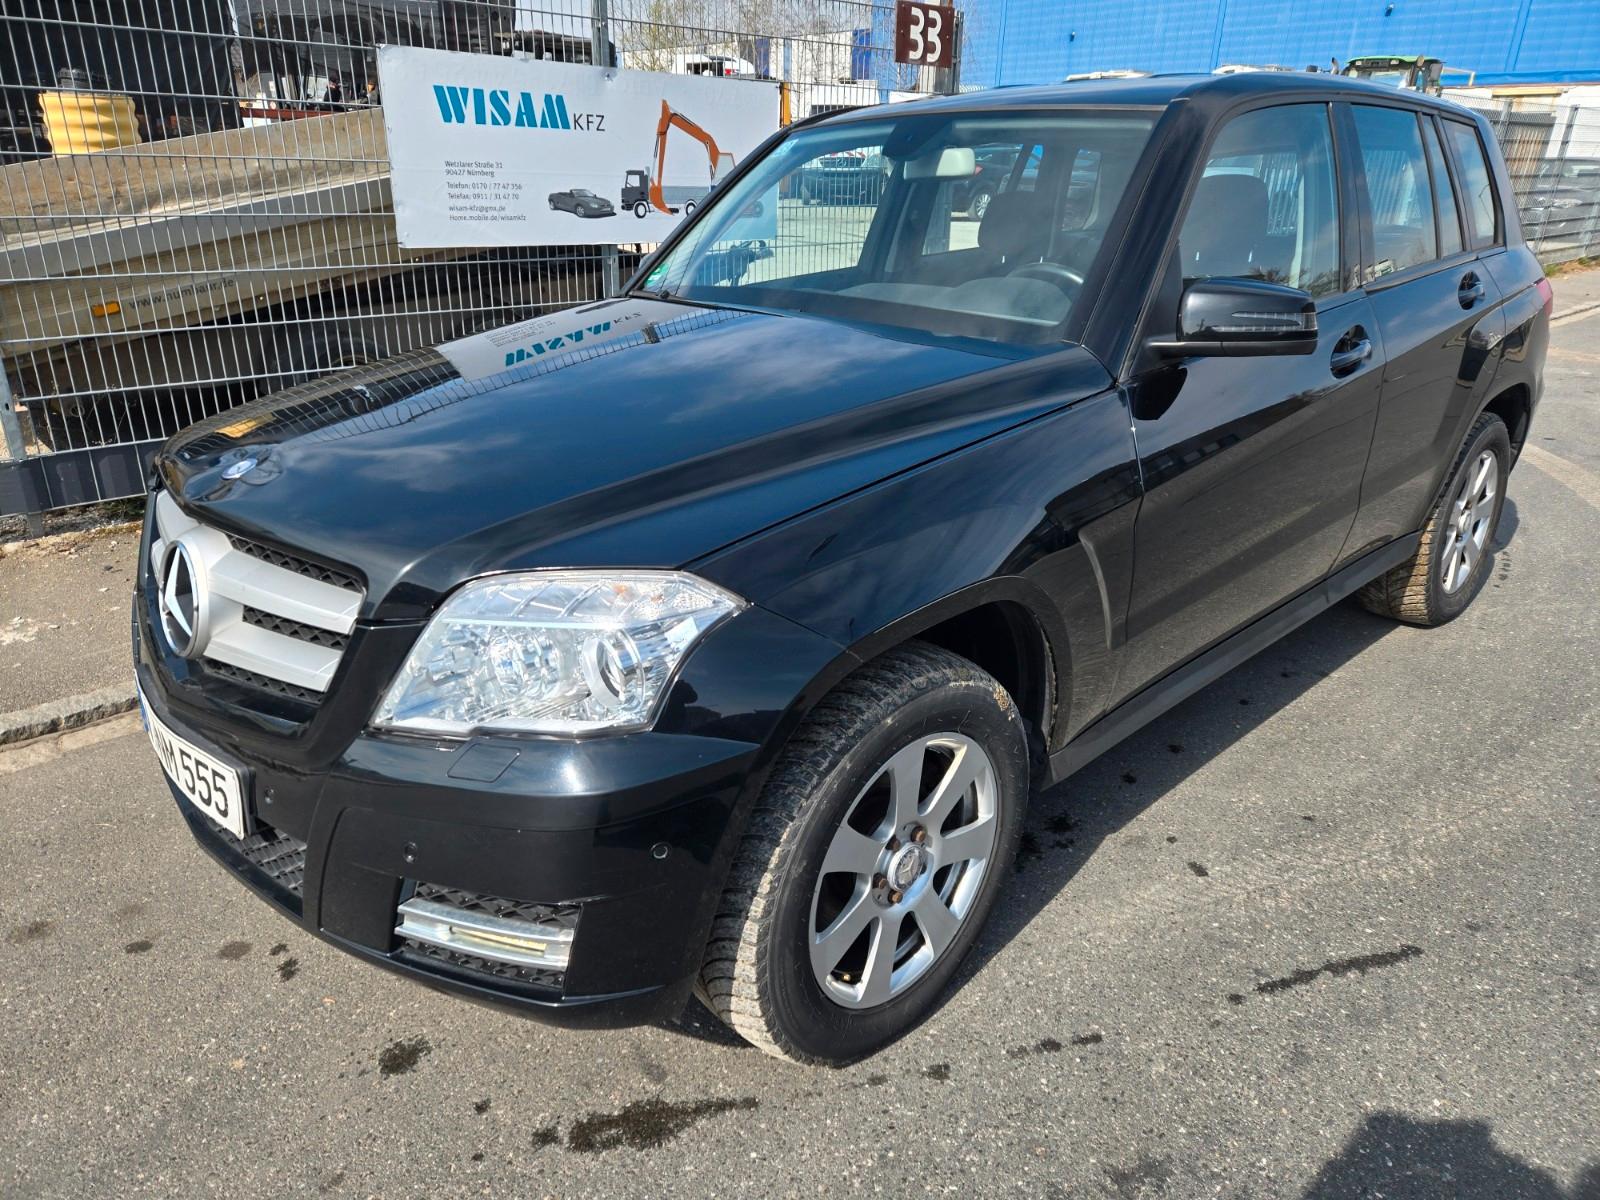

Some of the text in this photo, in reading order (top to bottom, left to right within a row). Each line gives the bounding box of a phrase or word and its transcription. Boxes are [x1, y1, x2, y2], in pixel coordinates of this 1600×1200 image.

[909, 6, 942, 63] 33
[432, 84, 606, 132] WISAM KFZ
[467, 169, 495, 178] Nürnberg
[474, 161, 494, 169] Straße
[179, 747, 229, 818] 555
